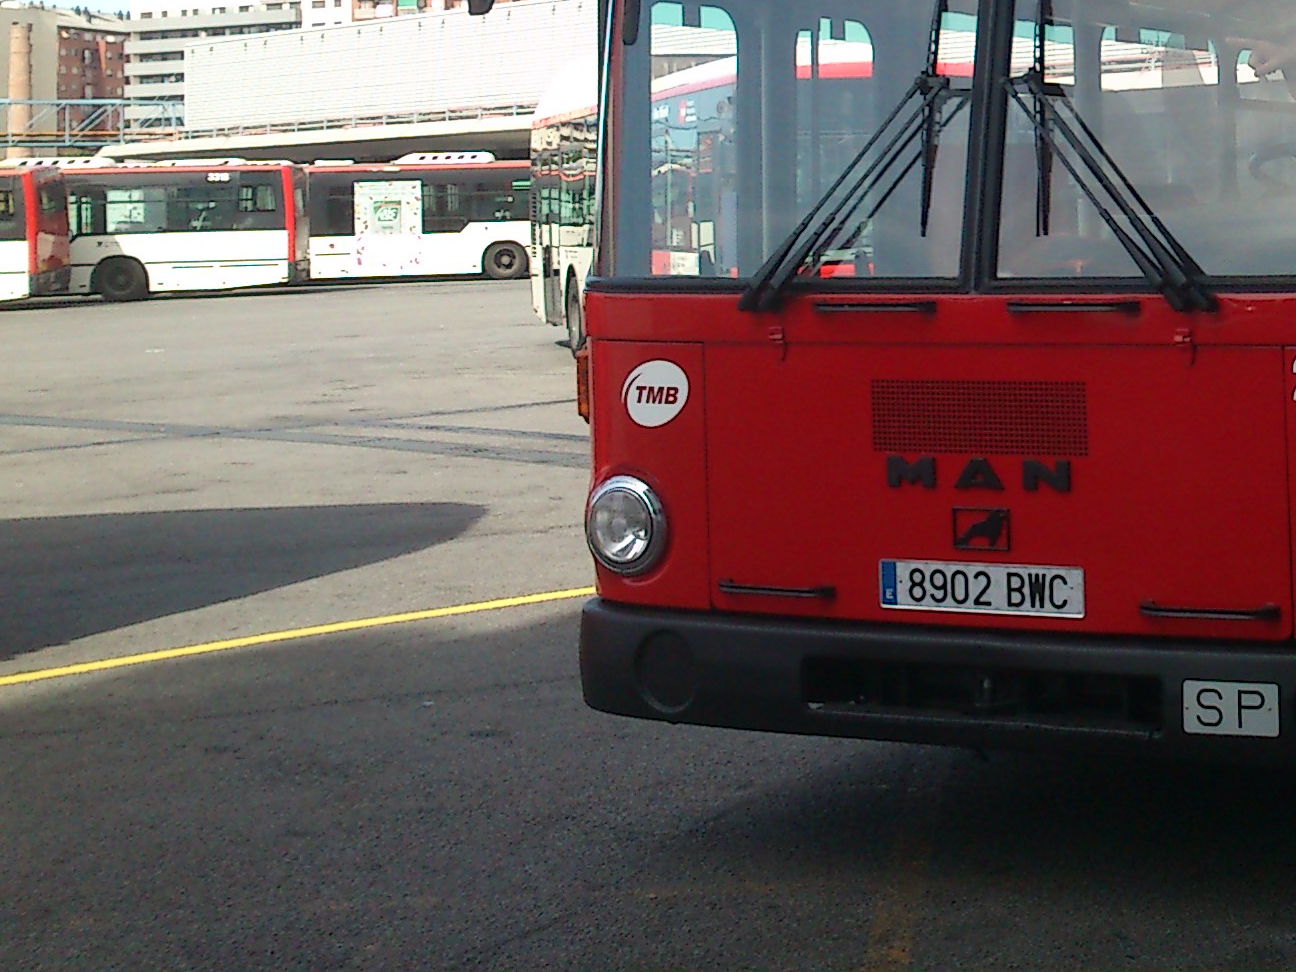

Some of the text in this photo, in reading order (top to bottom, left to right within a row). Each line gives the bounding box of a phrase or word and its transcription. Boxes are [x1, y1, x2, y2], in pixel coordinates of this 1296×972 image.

[635, 385, 679, 405] TMB
[886, 456, 1072, 492] MAN
[907, 567, 993, 607] 8902
[1006, 573, 1070, 610] BWC
[1195, 688, 1266, 730] SP
